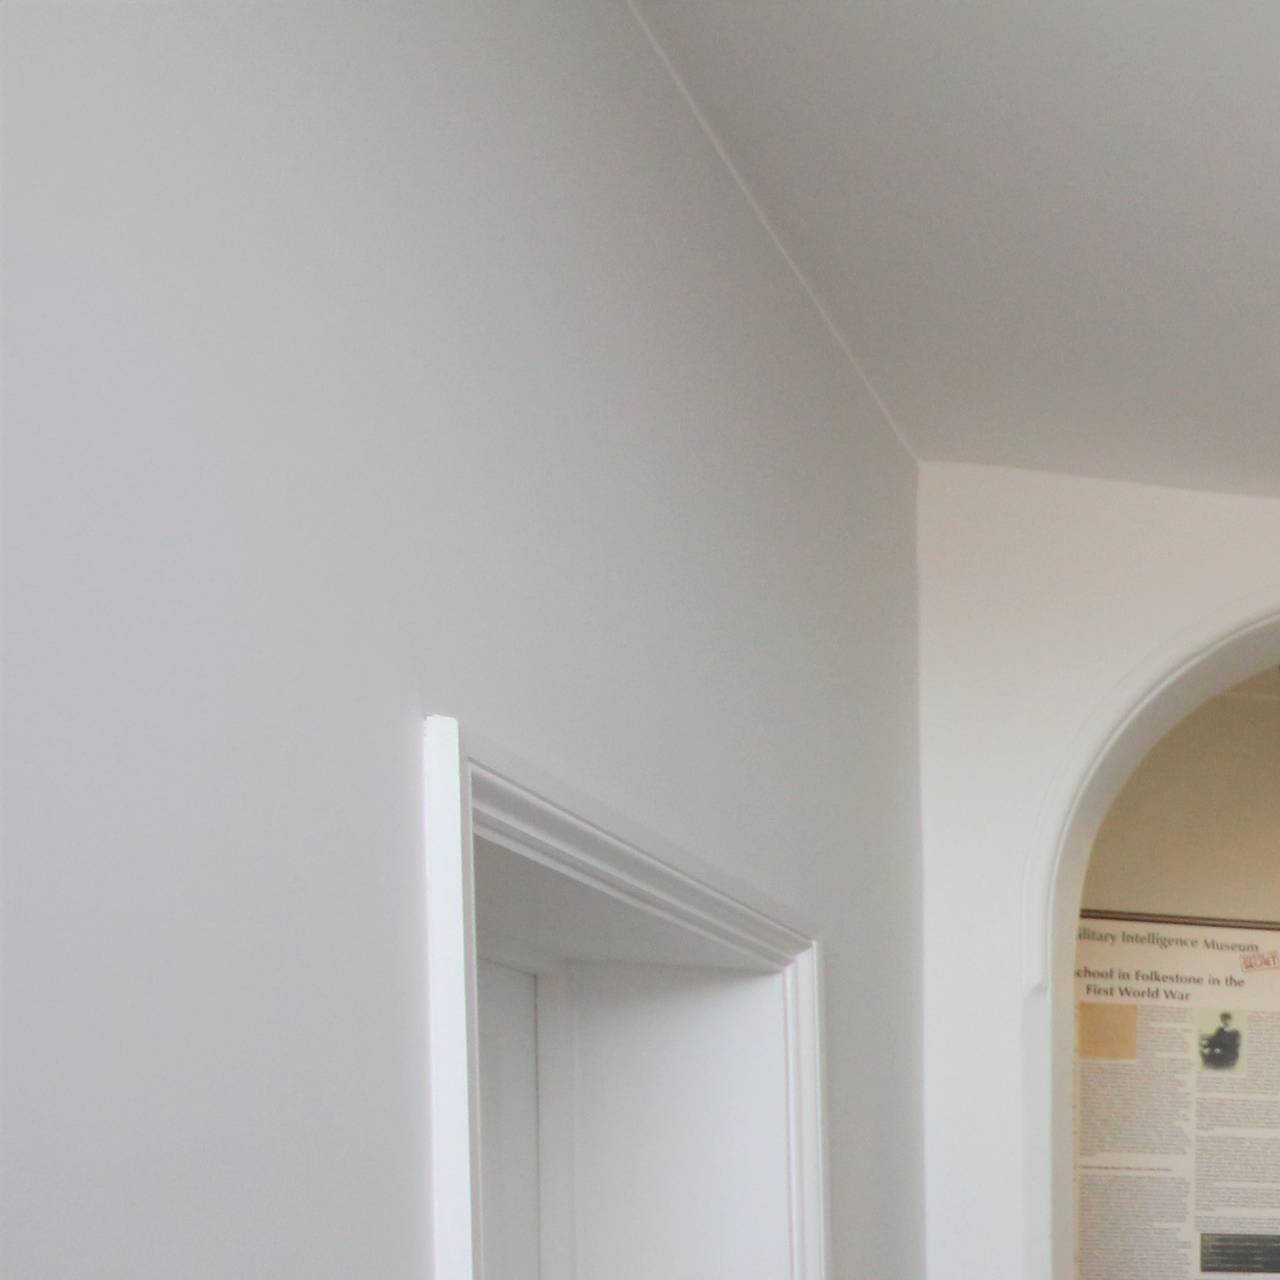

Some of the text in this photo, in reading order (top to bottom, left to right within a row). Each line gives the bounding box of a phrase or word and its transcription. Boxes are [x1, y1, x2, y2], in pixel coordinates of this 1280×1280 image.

[1121, 931, 1198, 950] Intelligence
[1203, 938, 1259, 952] Museum
[1118, 968, 1130, 981] in
[1135, 969, 1204, 986] Folkestone
[1208, 973, 1221, 986] in
[1225, 972, 1245, 988] the
[1085, 983, 1191, 1001] First World War
